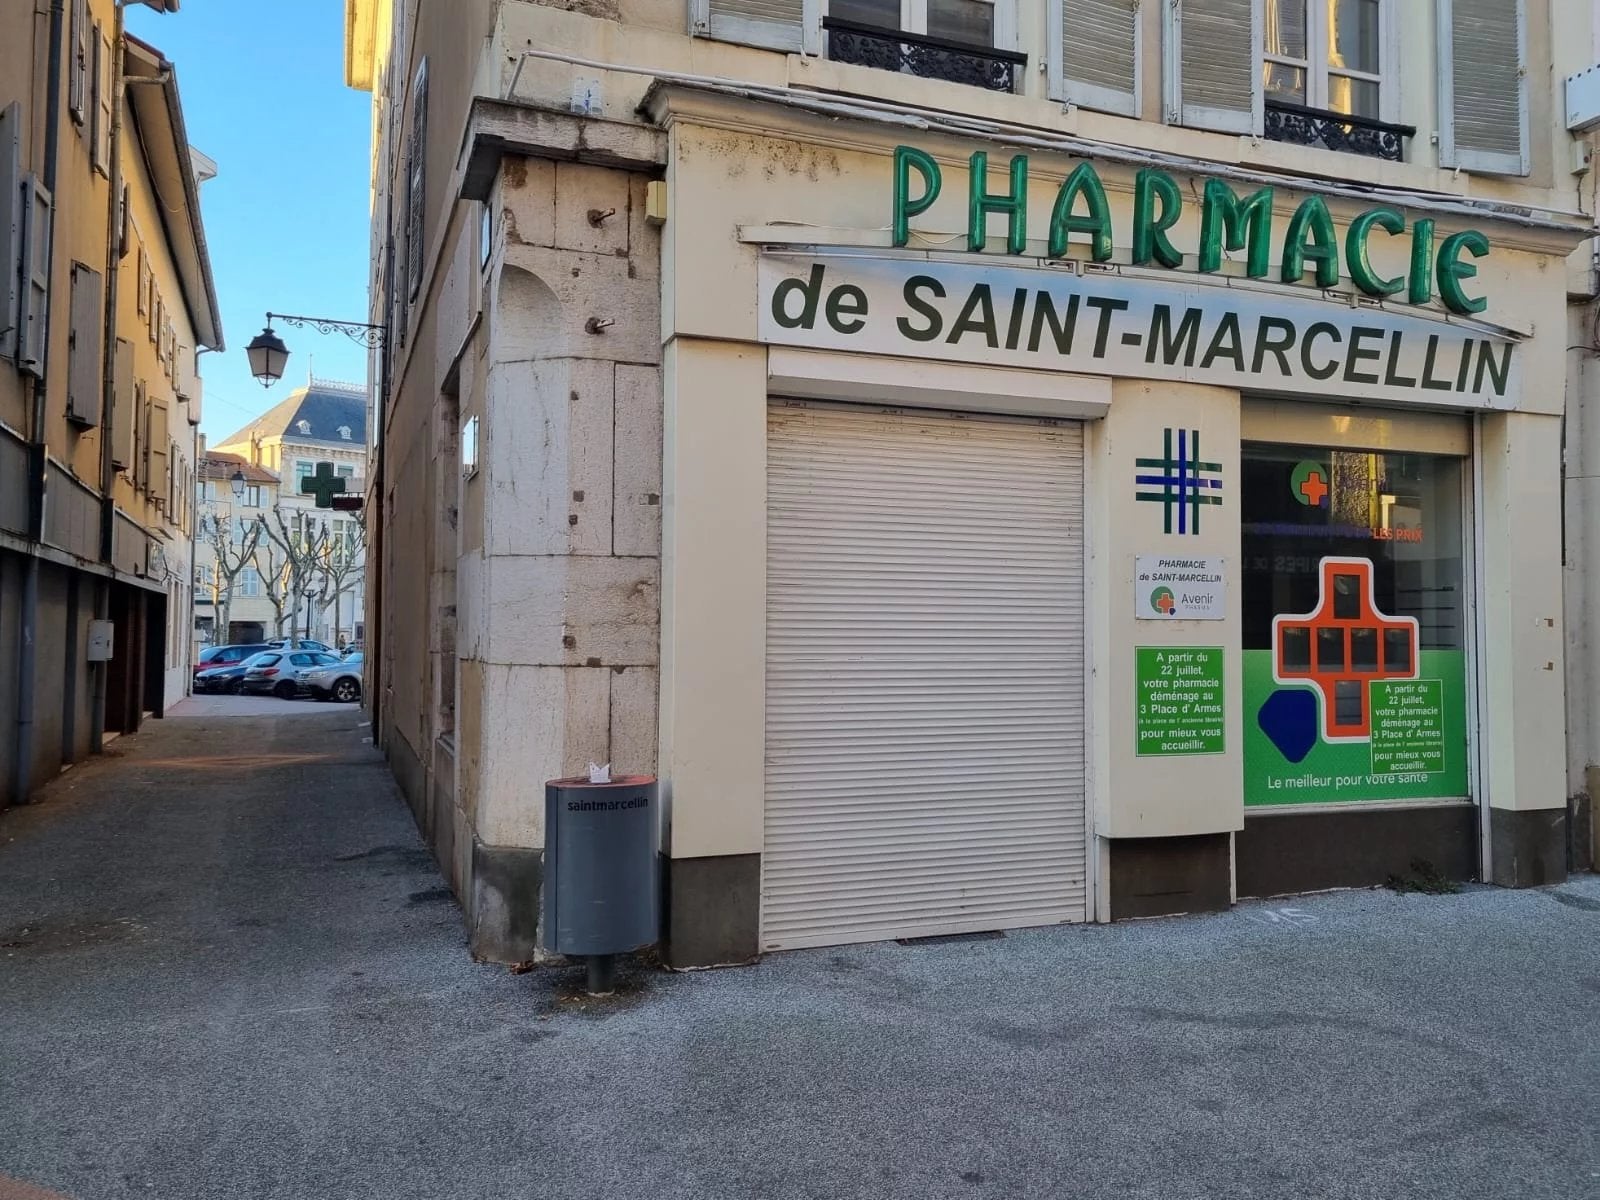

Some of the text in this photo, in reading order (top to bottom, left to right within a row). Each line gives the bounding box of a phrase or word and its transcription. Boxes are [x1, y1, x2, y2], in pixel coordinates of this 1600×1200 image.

[893, 145, 1489, 315] PHARMACIE
[771, 263, 1514, 396] de SAINT-MARCELLIN
[1158, 559, 1207, 569] PHARMACIE
[1139, 573, 1222, 583] de SAINT-MARCELLIN
[1181, 592, 1214, 604] Avenir
[1156, 652, 1208, 664] A partir du
[1161, 665, 1204, 677] 22 juillet,
[1143, 678, 1219, 689] votre pharmacie
[1385, 684, 1428, 694] A partir du
[1150, 691, 1214, 703] déménage au
[1388, 695, 1425, 706] 22 juillet,
[1140, 704, 1147, 714] 3
[1151, 704, 1178, 714] Place
[1193, 703, 1221, 713] Armes
[1375, 706, 1439, 717] votre pharmacie
[1380, 718, 1421, 728] déménage
[1141, 728, 1221, 740] pour mieux vous
[1373, 730, 1379, 739] 3
[1381, 730, 1403, 739] Place
[1416, 729, 1441, 738] Armes
[1161, 740, 1206, 750] accueillir.
[1374, 750, 1441, 762] pour mieux vous
[1390, 761, 1428, 771] accueillir.
[1267, 775, 1282, 789] Le
[1285, 774, 1332, 788] meilleur
[1336, 774, 1363, 790] pour
[1365, 775, 1395, 785] votre
[567, 796, 648, 812] saintmarcellin
